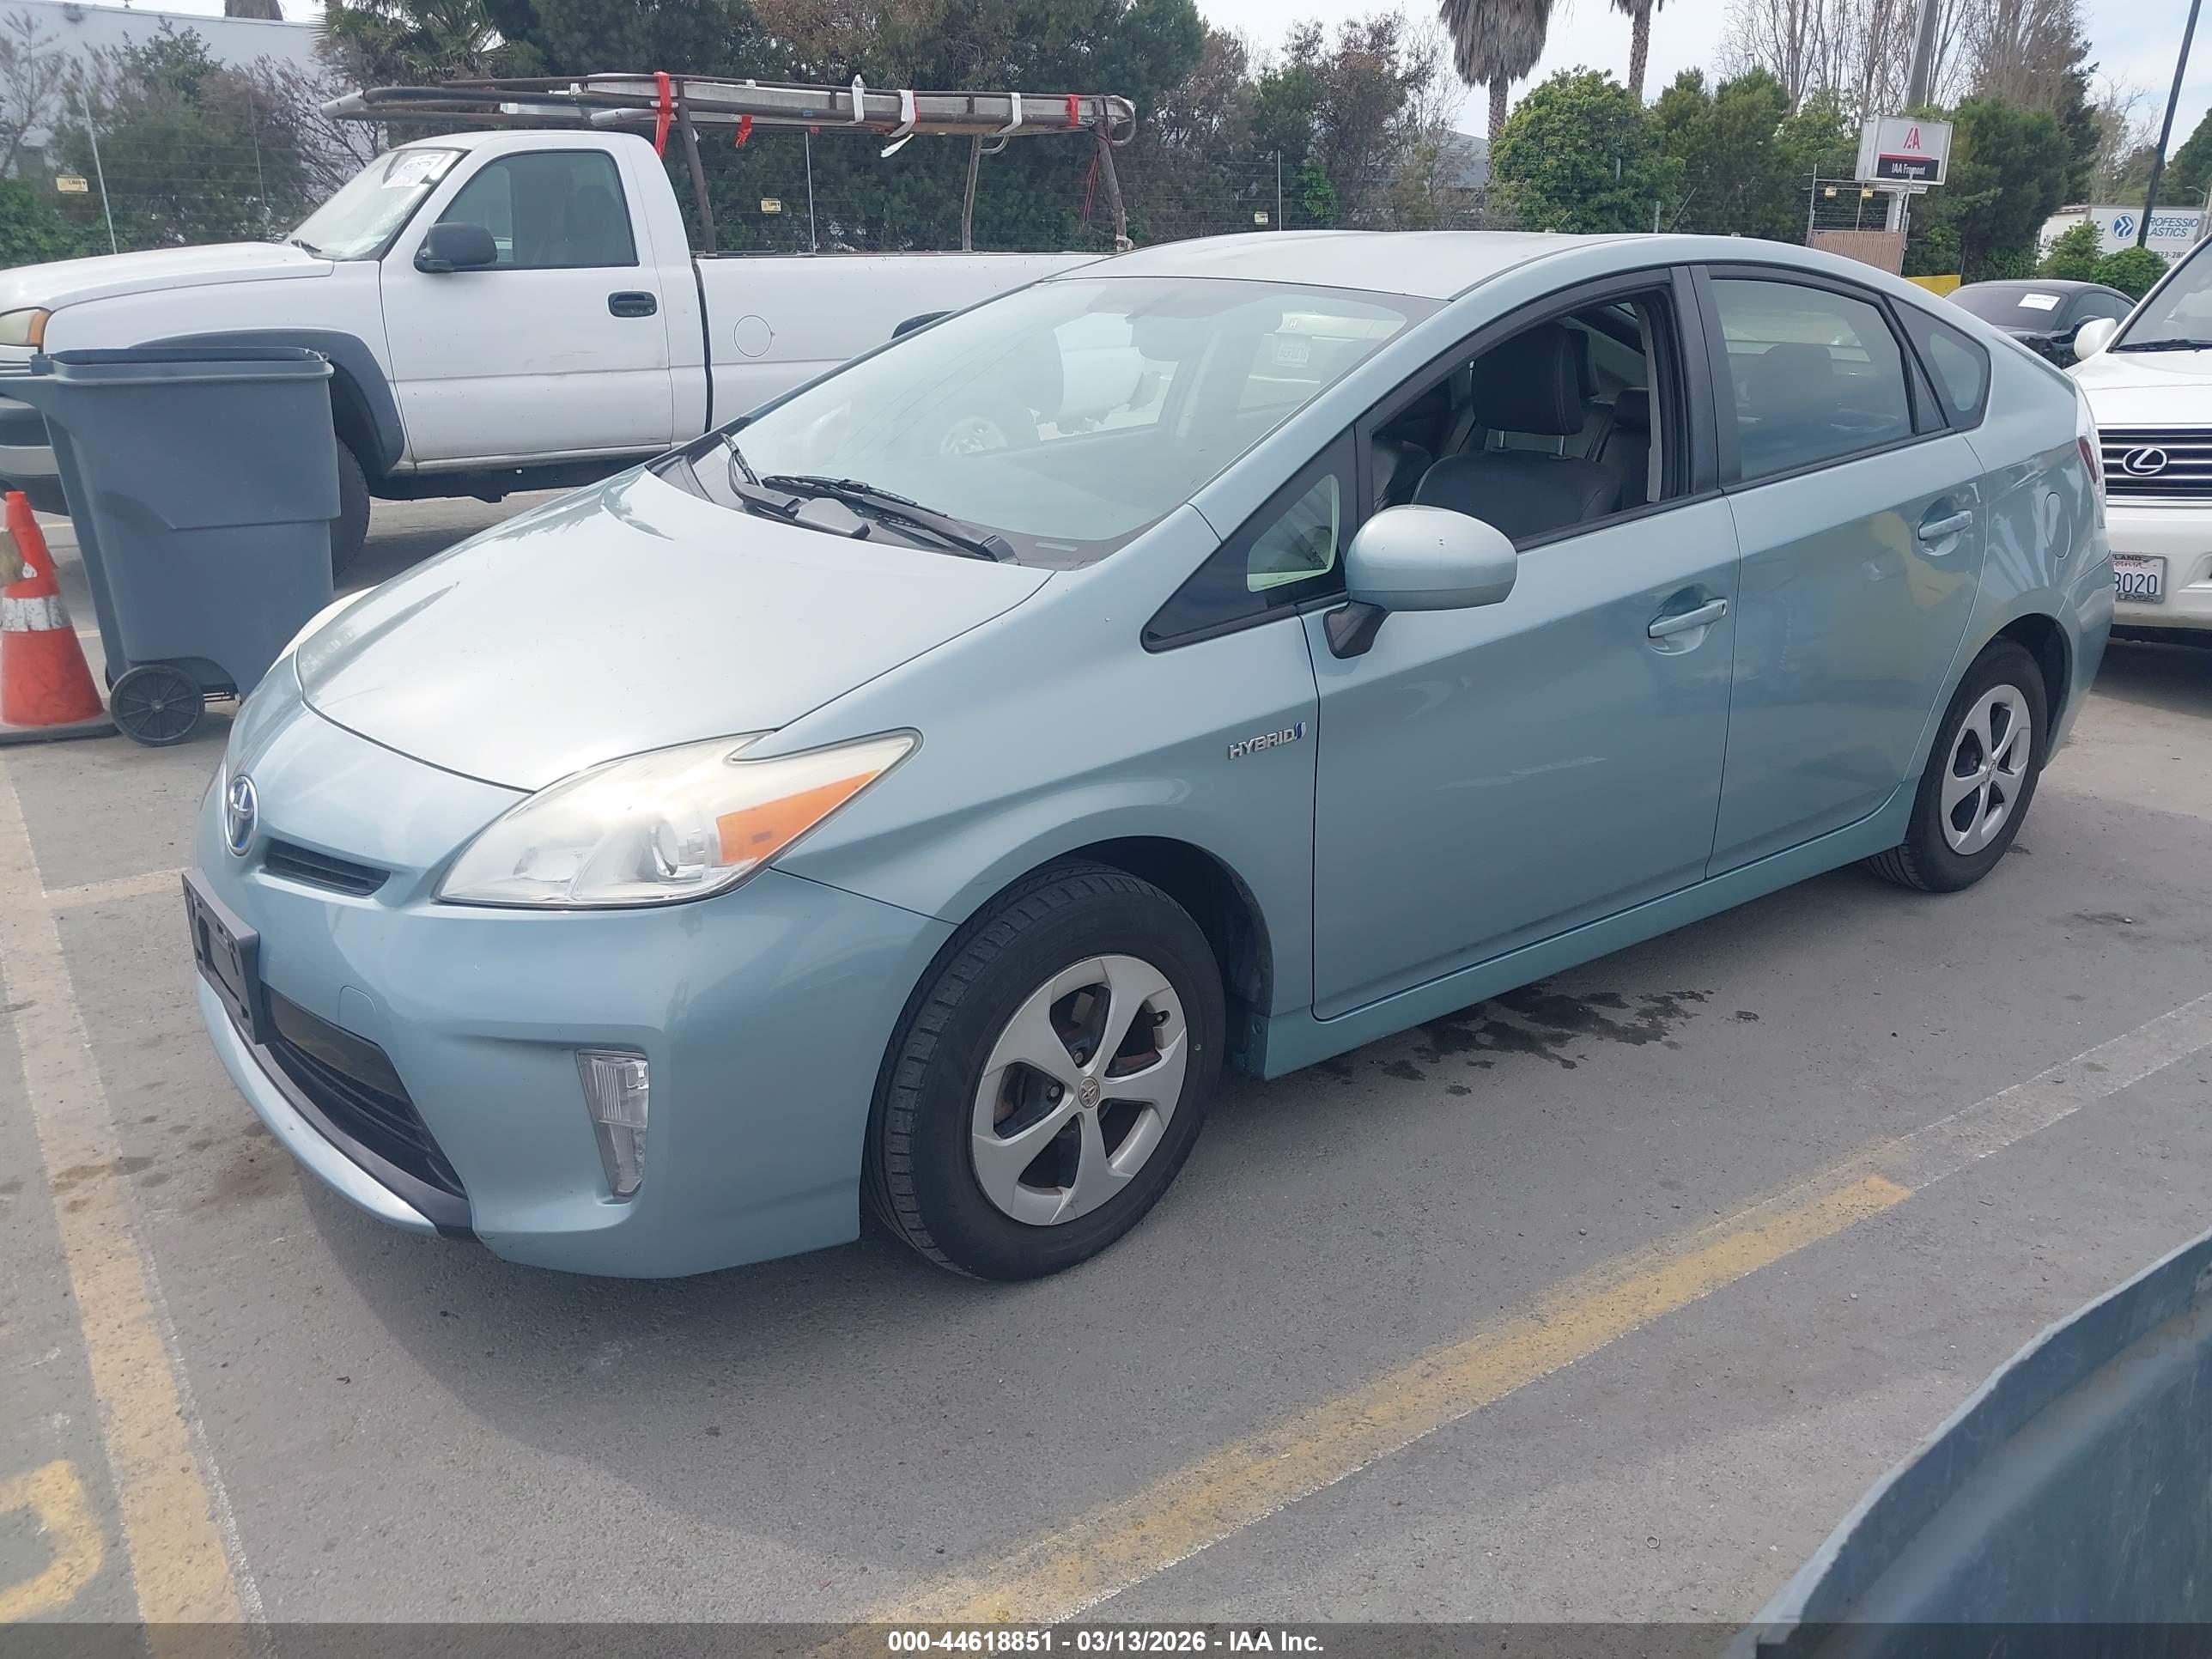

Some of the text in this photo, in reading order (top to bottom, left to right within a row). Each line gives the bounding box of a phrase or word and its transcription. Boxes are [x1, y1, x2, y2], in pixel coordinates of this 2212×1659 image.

[1892, 162, 1903, 174] IAA
[2148, 216, 2199, 228] ROFESSIO
[2148, 228, 2188, 237] ASTICS
[1228, 728, 1296, 760] HYBRID
